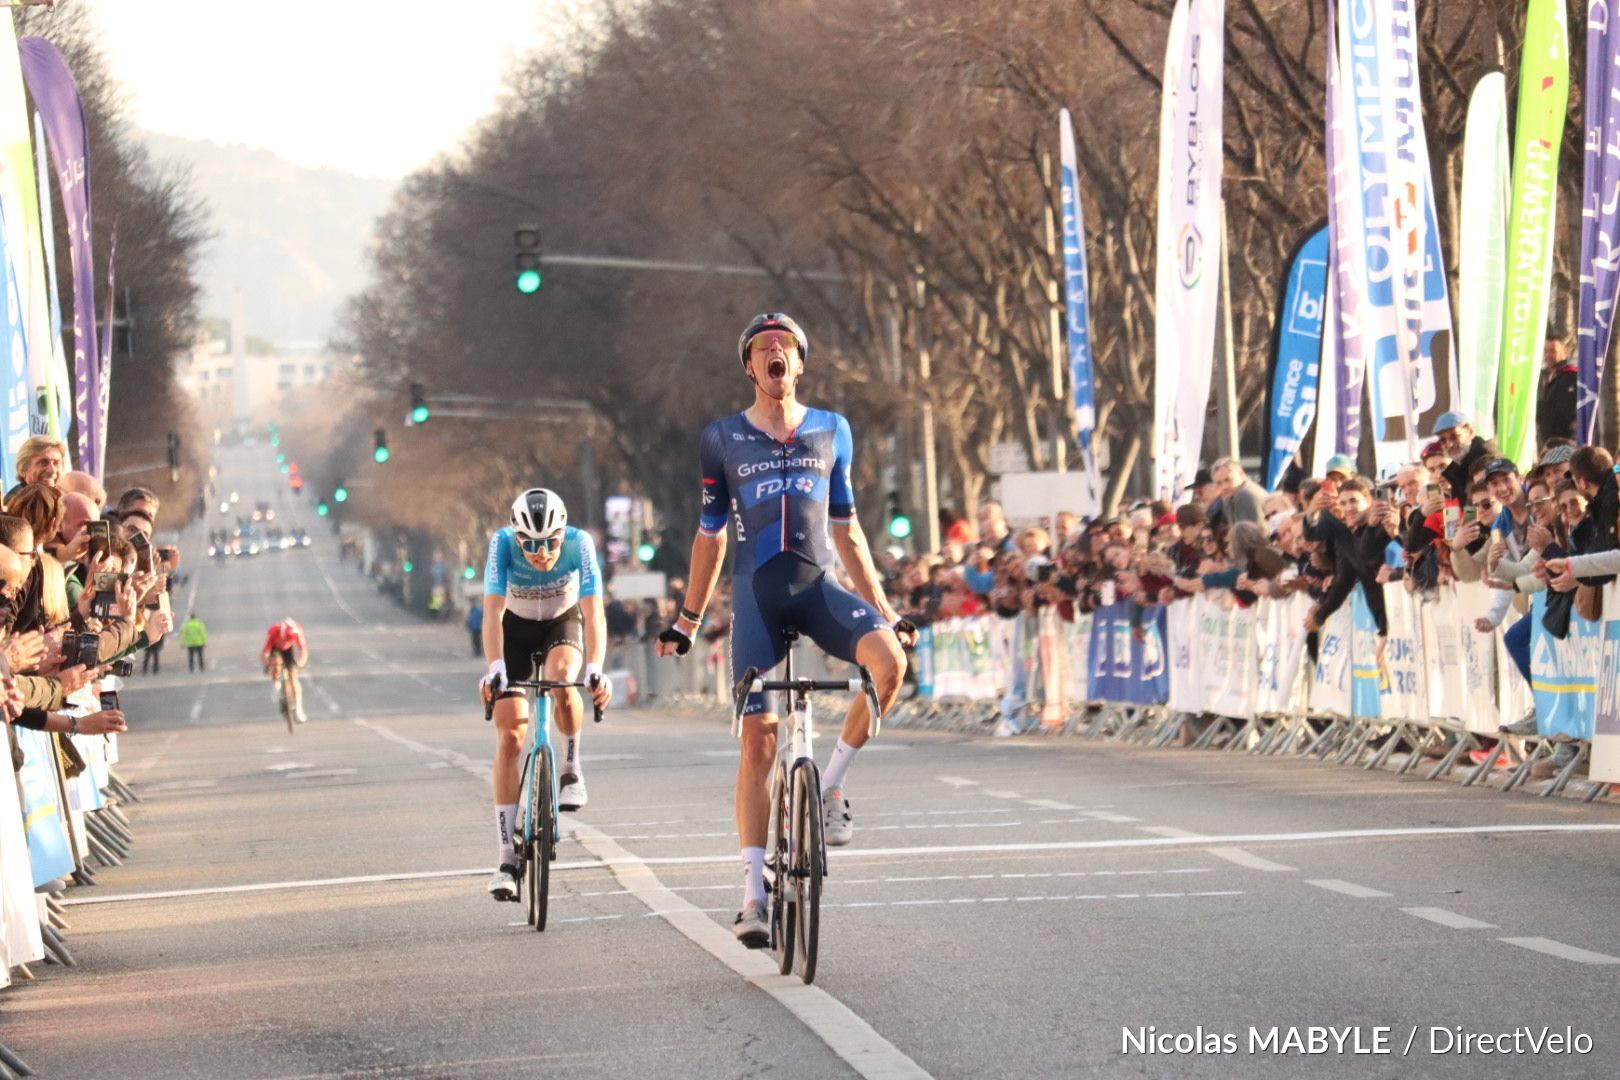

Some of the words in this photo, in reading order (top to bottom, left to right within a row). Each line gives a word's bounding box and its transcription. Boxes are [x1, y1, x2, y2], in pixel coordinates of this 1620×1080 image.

[1187, 34, 1200, 206] RYBLOS
[1351, 0, 1395, 283] OLYMPIC
[1277, 358, 1304, 418] france
[737, 457, 827, 477] Groupama
[756, 477, 793, 499] FDJ
